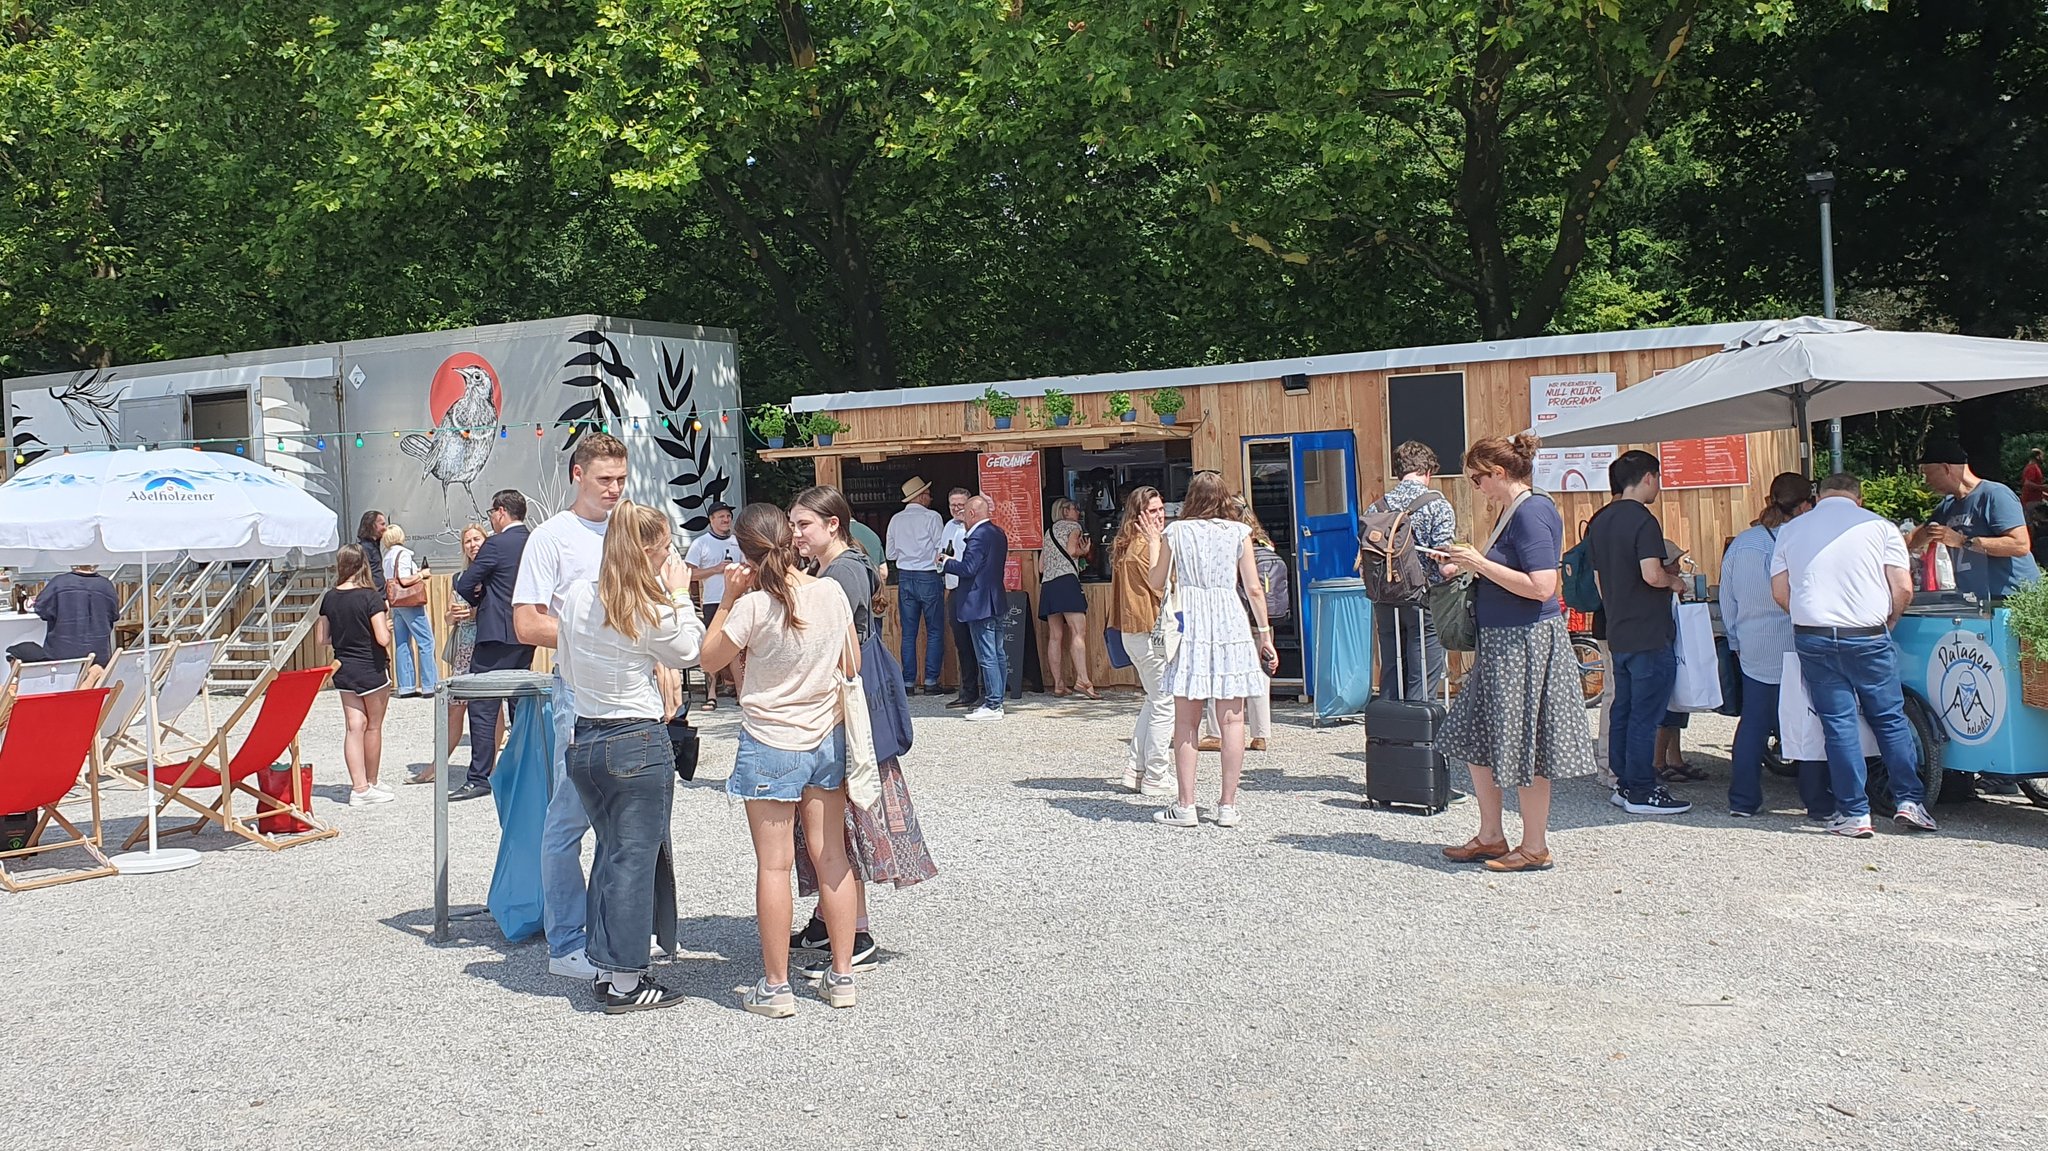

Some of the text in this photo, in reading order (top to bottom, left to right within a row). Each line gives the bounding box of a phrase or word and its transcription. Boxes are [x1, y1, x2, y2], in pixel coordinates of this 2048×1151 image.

[1546, 386, 1602, 397] NULL KULTUR
[126, 490, 215, 502] Adelholzener
[1938, 633, 1993, 673] Patagon
[1966, 715, 1991, 735] helados
